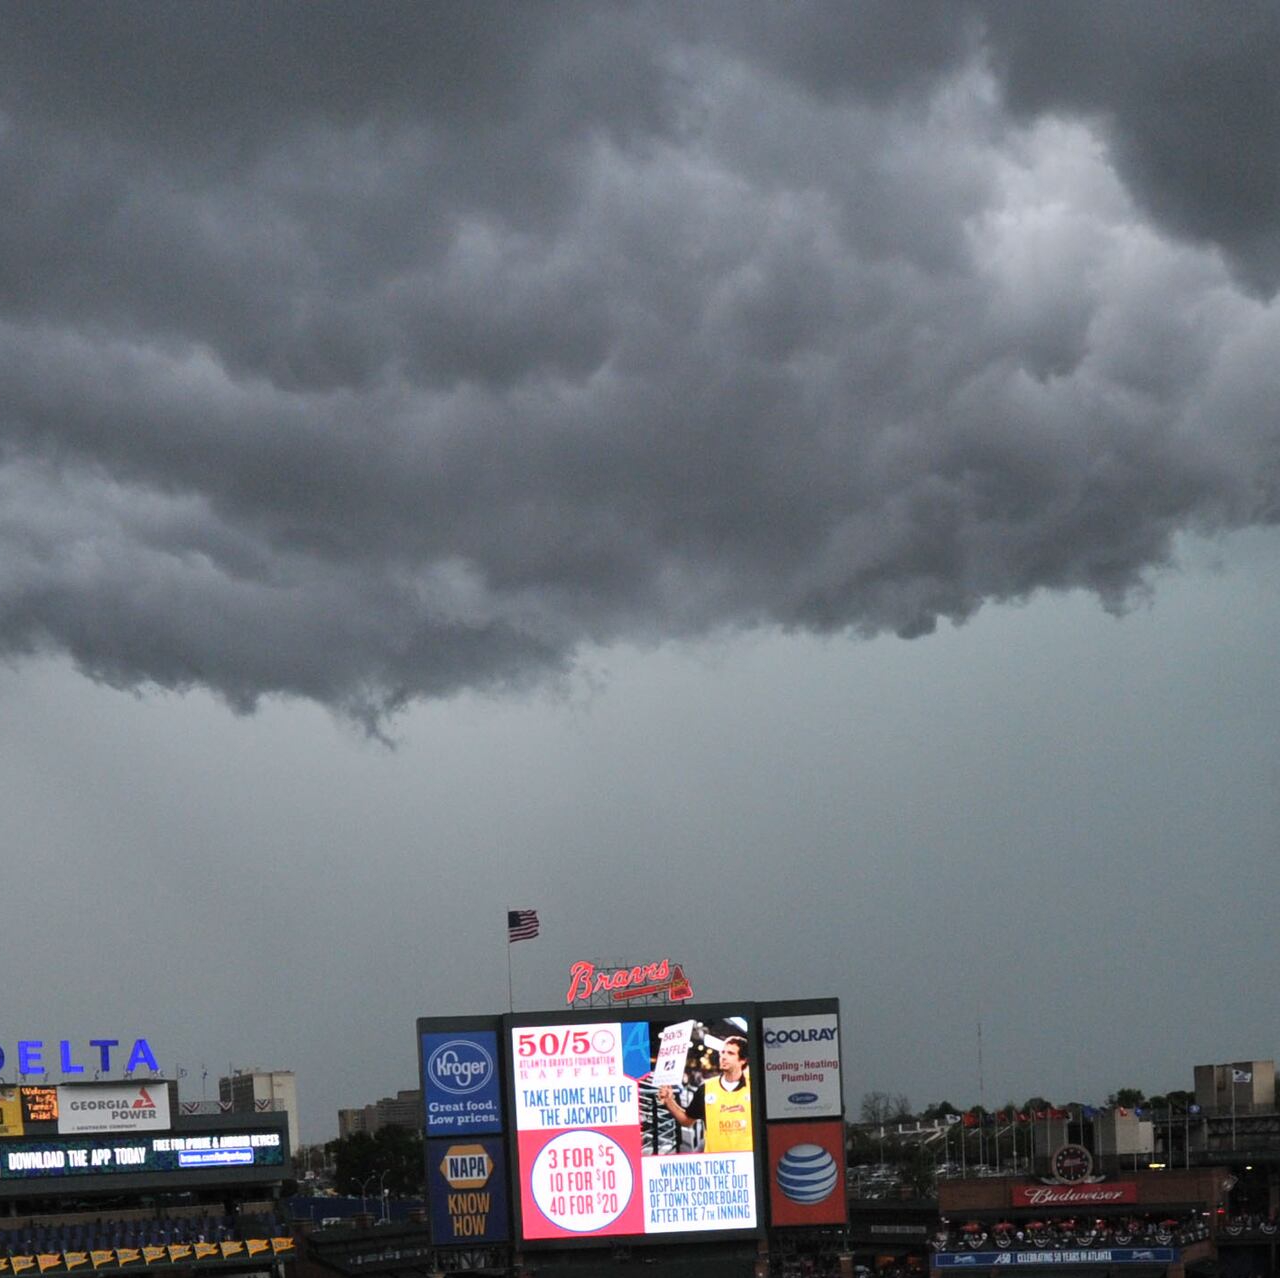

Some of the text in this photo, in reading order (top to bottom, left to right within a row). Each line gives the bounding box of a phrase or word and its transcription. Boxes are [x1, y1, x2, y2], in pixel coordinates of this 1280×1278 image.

[567, 959, 670, 1003] Braves
[764, 1028, 837, 1044] COOLRAY
[437, 1051, 486, 1086] Kroger
[519, 1056, 615, 1068] ATLANTA BRAVES FOUNDATION
[520, 1067, 616, 1079] RAFFLE
[781, 1073, 824, 1082] Plumbing
[22, 1087, 56, 1095] Welcome
[523, 1085, 632, 1107] TAKE HOME HALF OF
[70, 1100, 129, 1111] GEORGIA
[111, 1109, 156, 1120] POWER
[429, 1101, 497, 1112] Great food.
[429, 1113, 499, 1125] Low prices.
[540, 1106, 618, 1126] THE JACKPOT!
[153, 1139, 169, 1151] FREE
[171, 1138, 185, 1150] FOR
[220, 1136, 250, 1147] ANDROID
[251, 1134, 280, 1147] DEVICES
[9, 1147, 146, 1170] DOWNLOAD THE APP TODAY
[548, 1145, 614, 1169] 3 FOR $5
[450, 1157, 486, 1178] NAPA
[660, 1160, 735, 1177] WINNING TICKET
[550, 1169, 615, 1192] 10 FOR $10
[649, 1174, 748, 1193] DISPLAYED ON THE OUT
[448, 1192, 490, 1215] KNOW
[550, 1192, 618, 1216] 40 FOR $20
[650, 1190, 749, 1208] OF TOWN SCOREBOARD
[1024, 1187, 1124, 1205] Budweiser
[651, 1208, 678, 1223] AFTER
[681, 1207, 698, 1222] THE
[717, 1204, 750, 1219] INNING
[454, 1215, 486, 1236] HOW
[1017, 1253, 1053, 1262] CELEBRATING
[1063, 1252, 1080, 1262] YEARS
[1080, 1252, 1087, 1261] IN
[1088, 1251, 1112, 1261] ATLANTA
